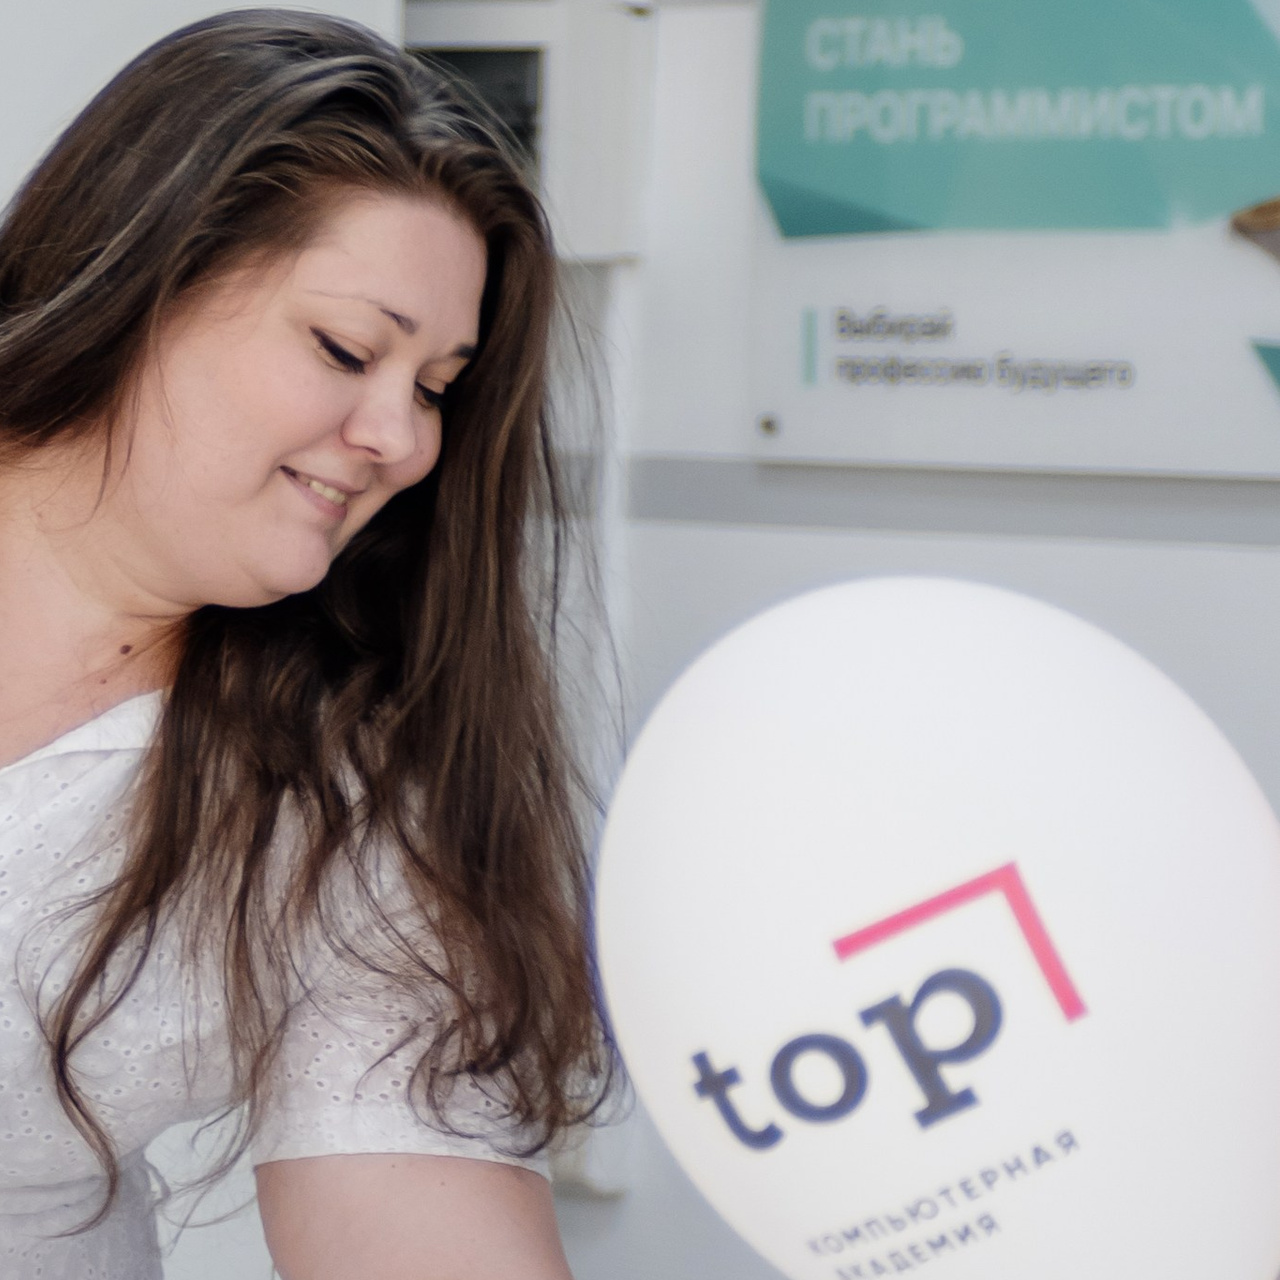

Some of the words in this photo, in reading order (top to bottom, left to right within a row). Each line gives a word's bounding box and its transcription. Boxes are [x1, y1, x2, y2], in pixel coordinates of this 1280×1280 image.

[804, 17, 964, 70] СТАНЬ
[804, 83, 1266, 144] ПРОГРАММИСТОМ
[690, 966, 1006, 1153] top
[807, 1127, 1080, 1255] КОМПЬЮТЕРНАЯ
